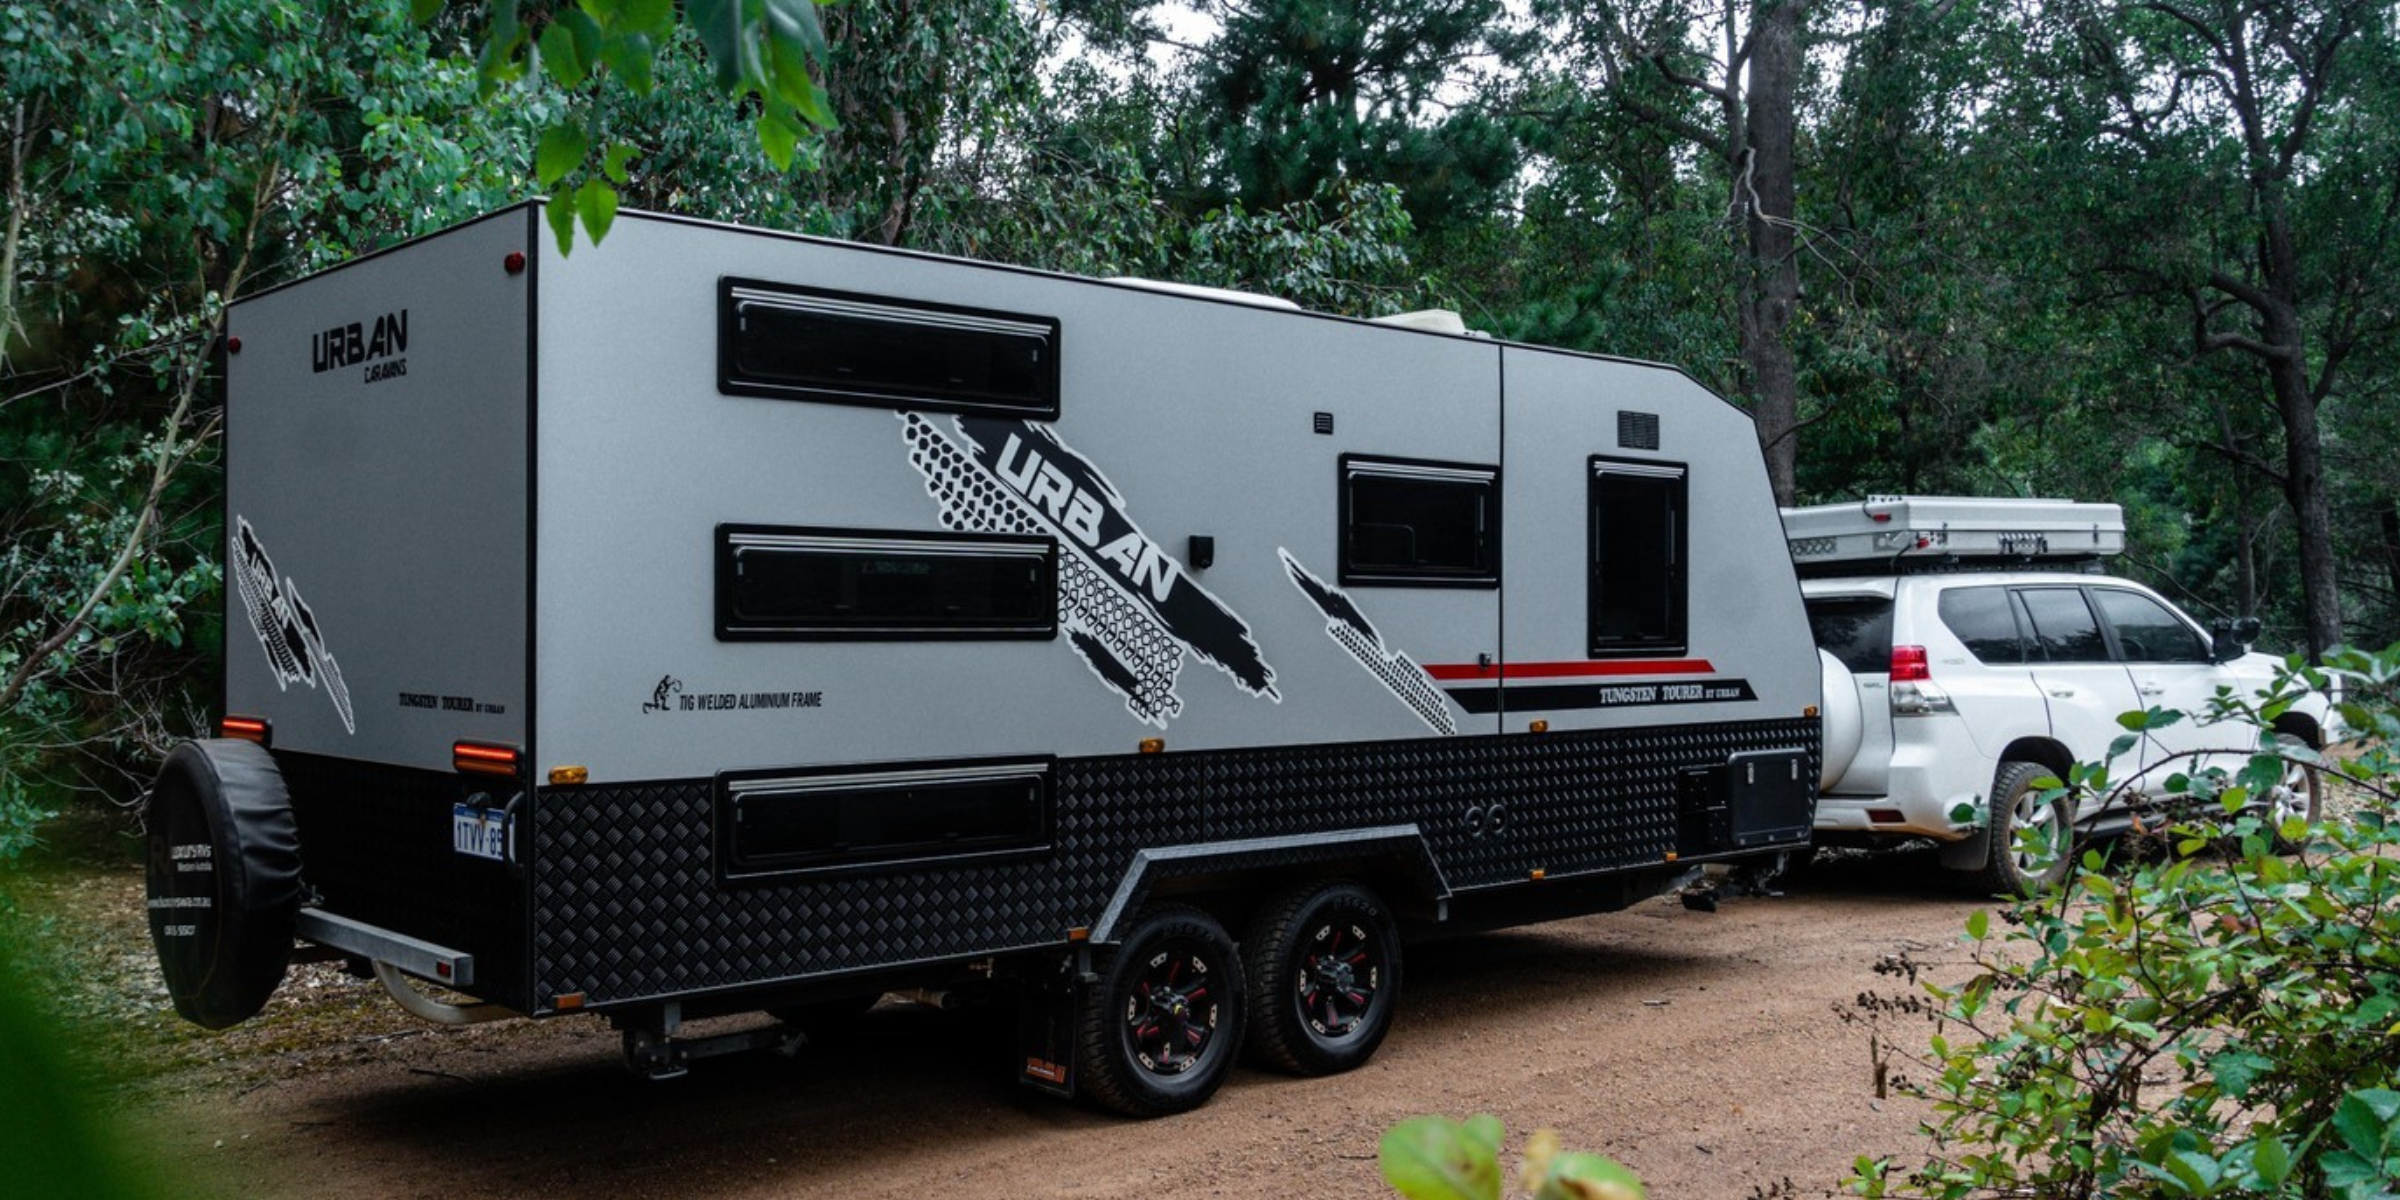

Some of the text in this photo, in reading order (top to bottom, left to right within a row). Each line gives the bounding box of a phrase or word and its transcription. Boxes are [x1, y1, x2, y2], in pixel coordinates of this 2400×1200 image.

[313, 309, 407, 373] URBAN
[364, 358, 407, 384] CARAVANS
[994, 432, 1182, 602] URBAN
[250, 552, 291, 629] URBAN
[399, 692, 438, 709] TUNGSTEN
[441, 695, 474, 712] TOURER
[679, 691, 823, 711] TIG WELDED ALUMINIUM FRAME
[1600, 686, 1657, 704] TUNGSTEN
[1662, 684, 1703, 701] TOURER
[1716, 687, 1740, 698] URBAN
